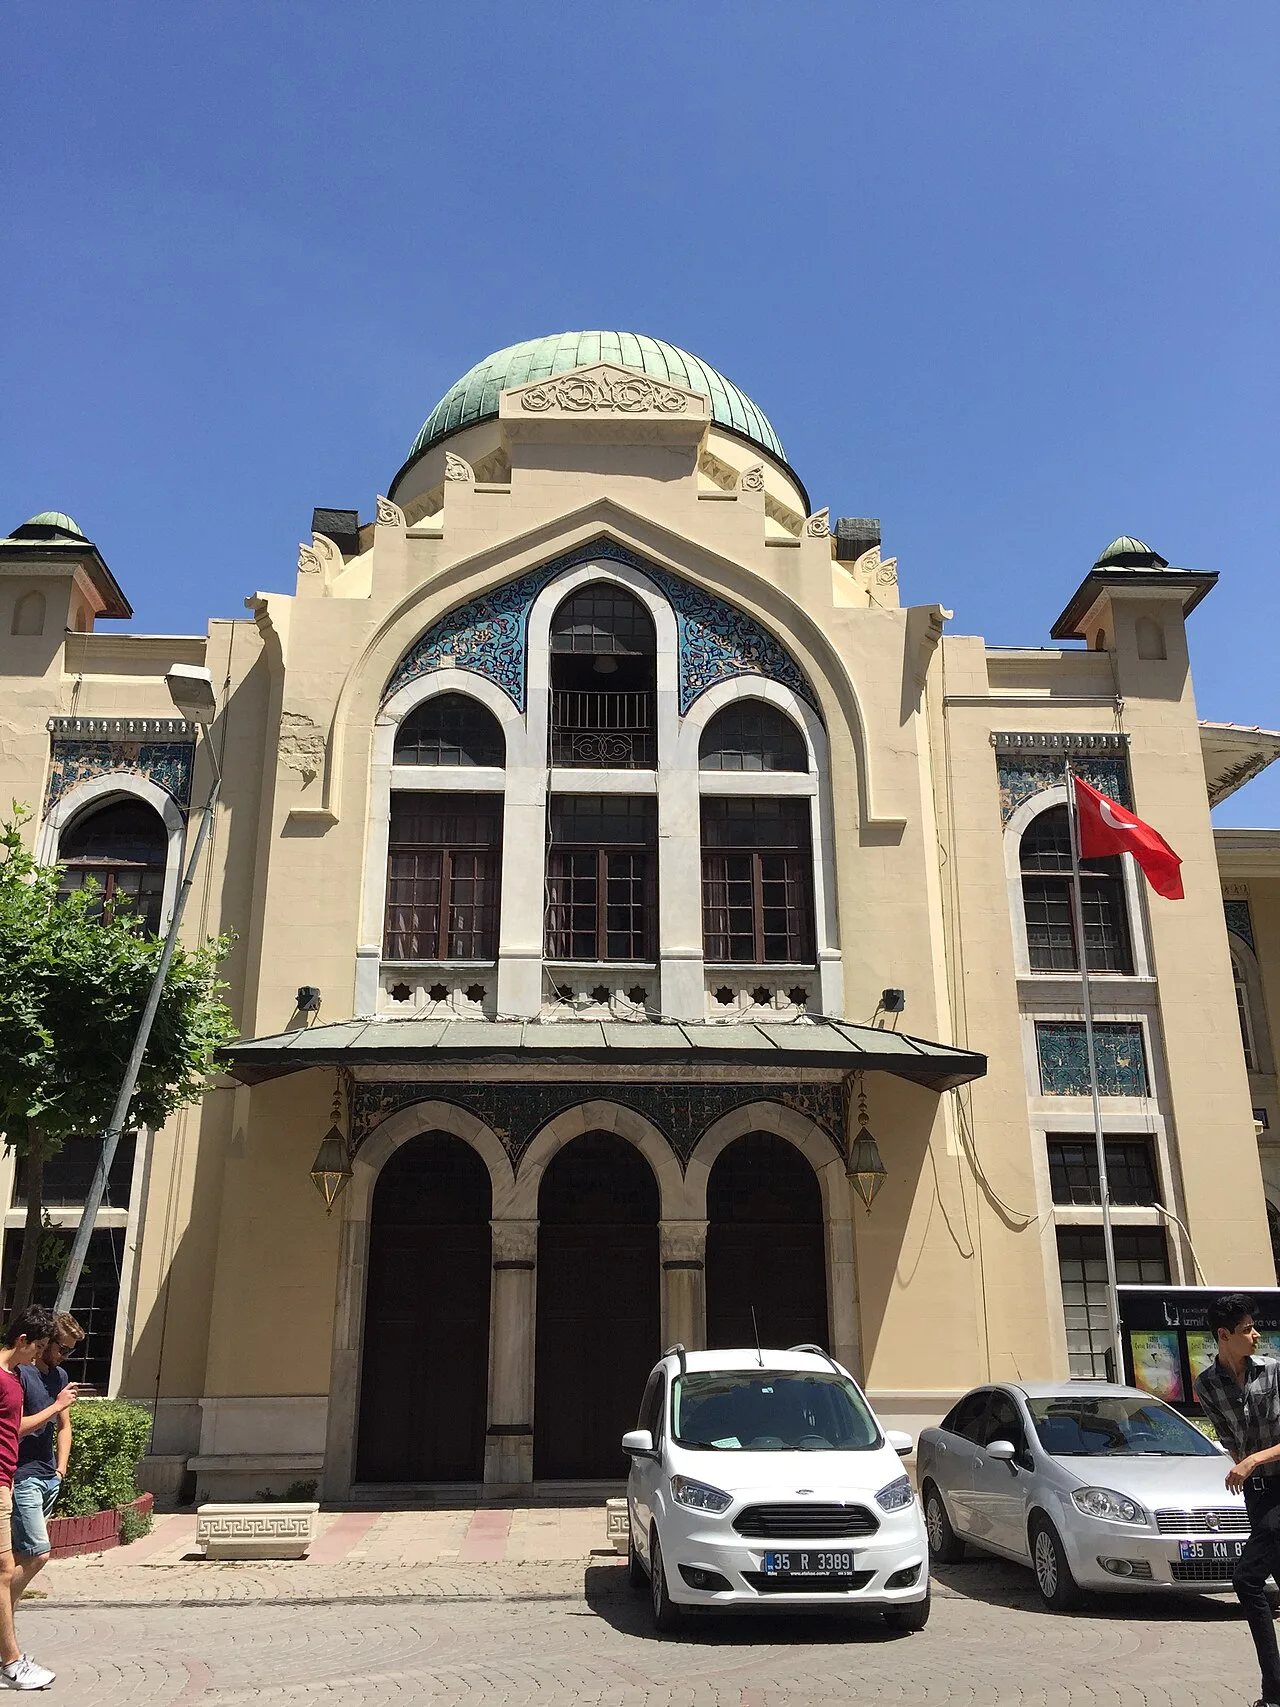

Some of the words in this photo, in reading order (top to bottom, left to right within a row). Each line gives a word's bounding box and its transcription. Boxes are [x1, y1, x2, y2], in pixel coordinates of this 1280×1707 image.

[1188, 1543, 1204, 1558] 35
[1212, 1542, 1228, 1557] KN
[1234, 1542, 1247, 1556] 8
[774, 1553, 790, 1570] 35
[801, 1553, 809, 1570] R
[817, 1553, 850, 1570] 3389
